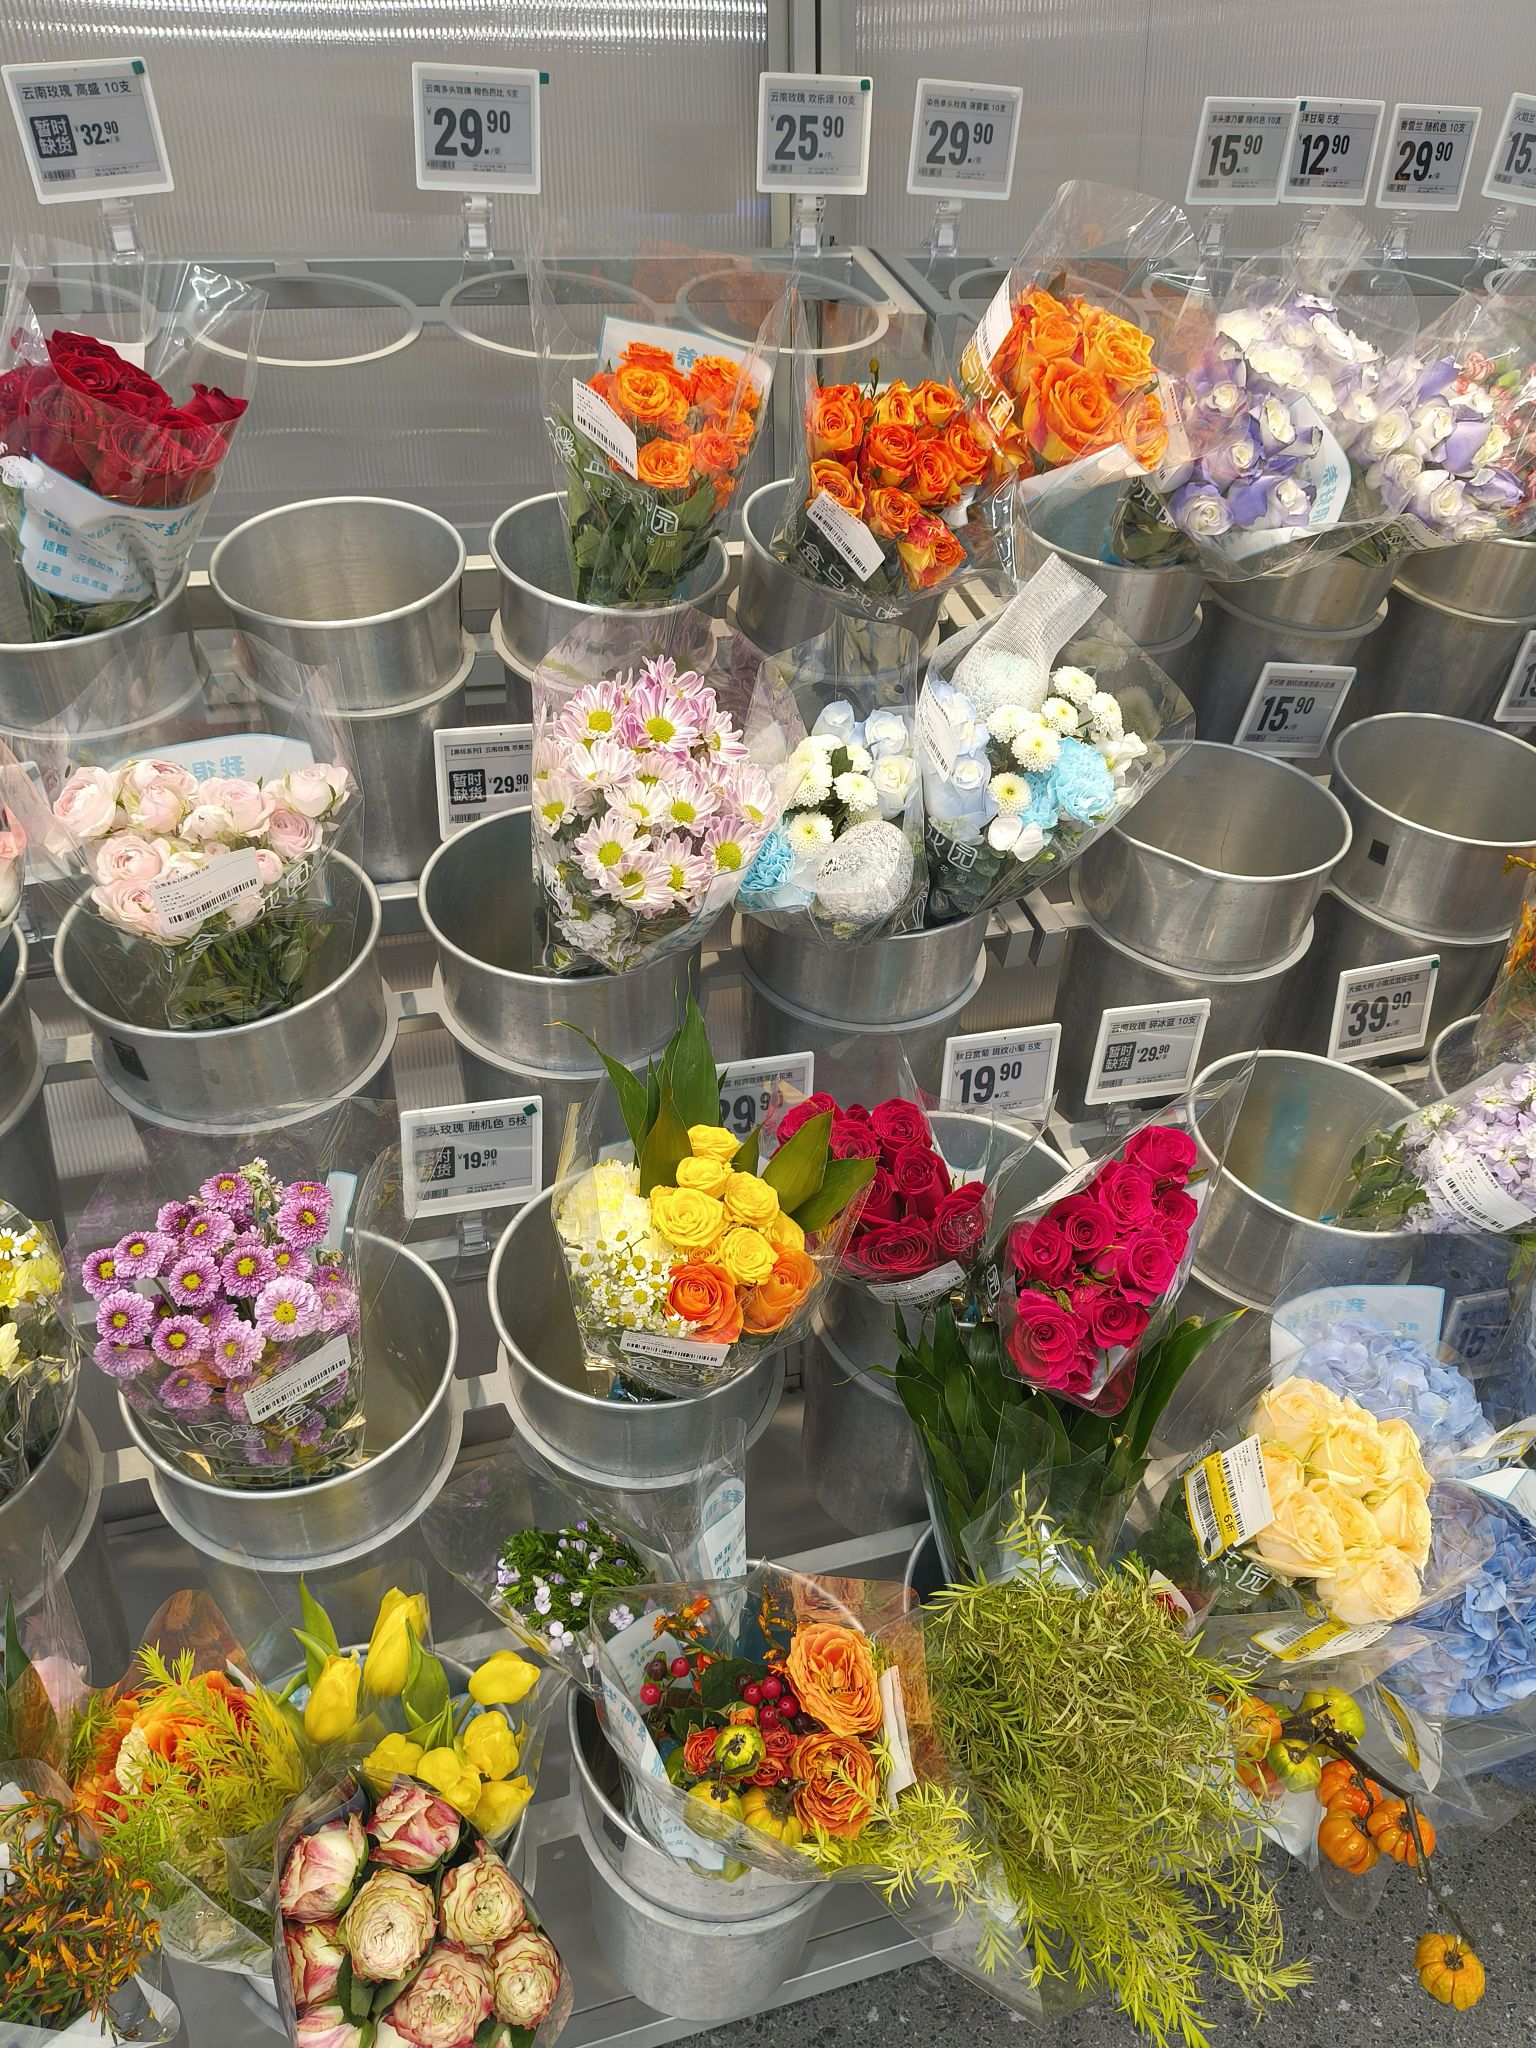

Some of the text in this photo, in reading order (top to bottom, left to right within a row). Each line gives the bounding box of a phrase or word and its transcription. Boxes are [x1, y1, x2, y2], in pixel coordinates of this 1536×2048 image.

[22, 80, 131, 100] 云南玫瑰 高盛 10支
[425, 84, 472, 95] 云南多头玫瑰
[770, 92, 856, 106] 云南玫瑰 欢乐颂 10支
[1301, 113, 1340, 125] 洋甘菊 5支
[34, 118, 68, 138] 暂时
[1400, 120, 1467, 134] 香雪兰 随机色 10支
[38, 136, 74, 154] 缺货
[36, 560, 63, 578] 注意
[486, 745, 510, 754] 云南玫瑰
[453, 772, 482, 788] 暂时
[454, 786, 483, 801] 缺货
[1111, 1015, 1198, 1034] 云南玫瑰 碎冰蓝 10支
[1028, 1042, 1042, 1051] 5支
[1108, 1044, 1133, 1059] 暂时
[1105, 1056, 1131, 1070] 缺货
[415, 1115, 528, 1138] 多头玫瑰 随机色 5枝
[1223, 1513, 1236, 1533] 6折
